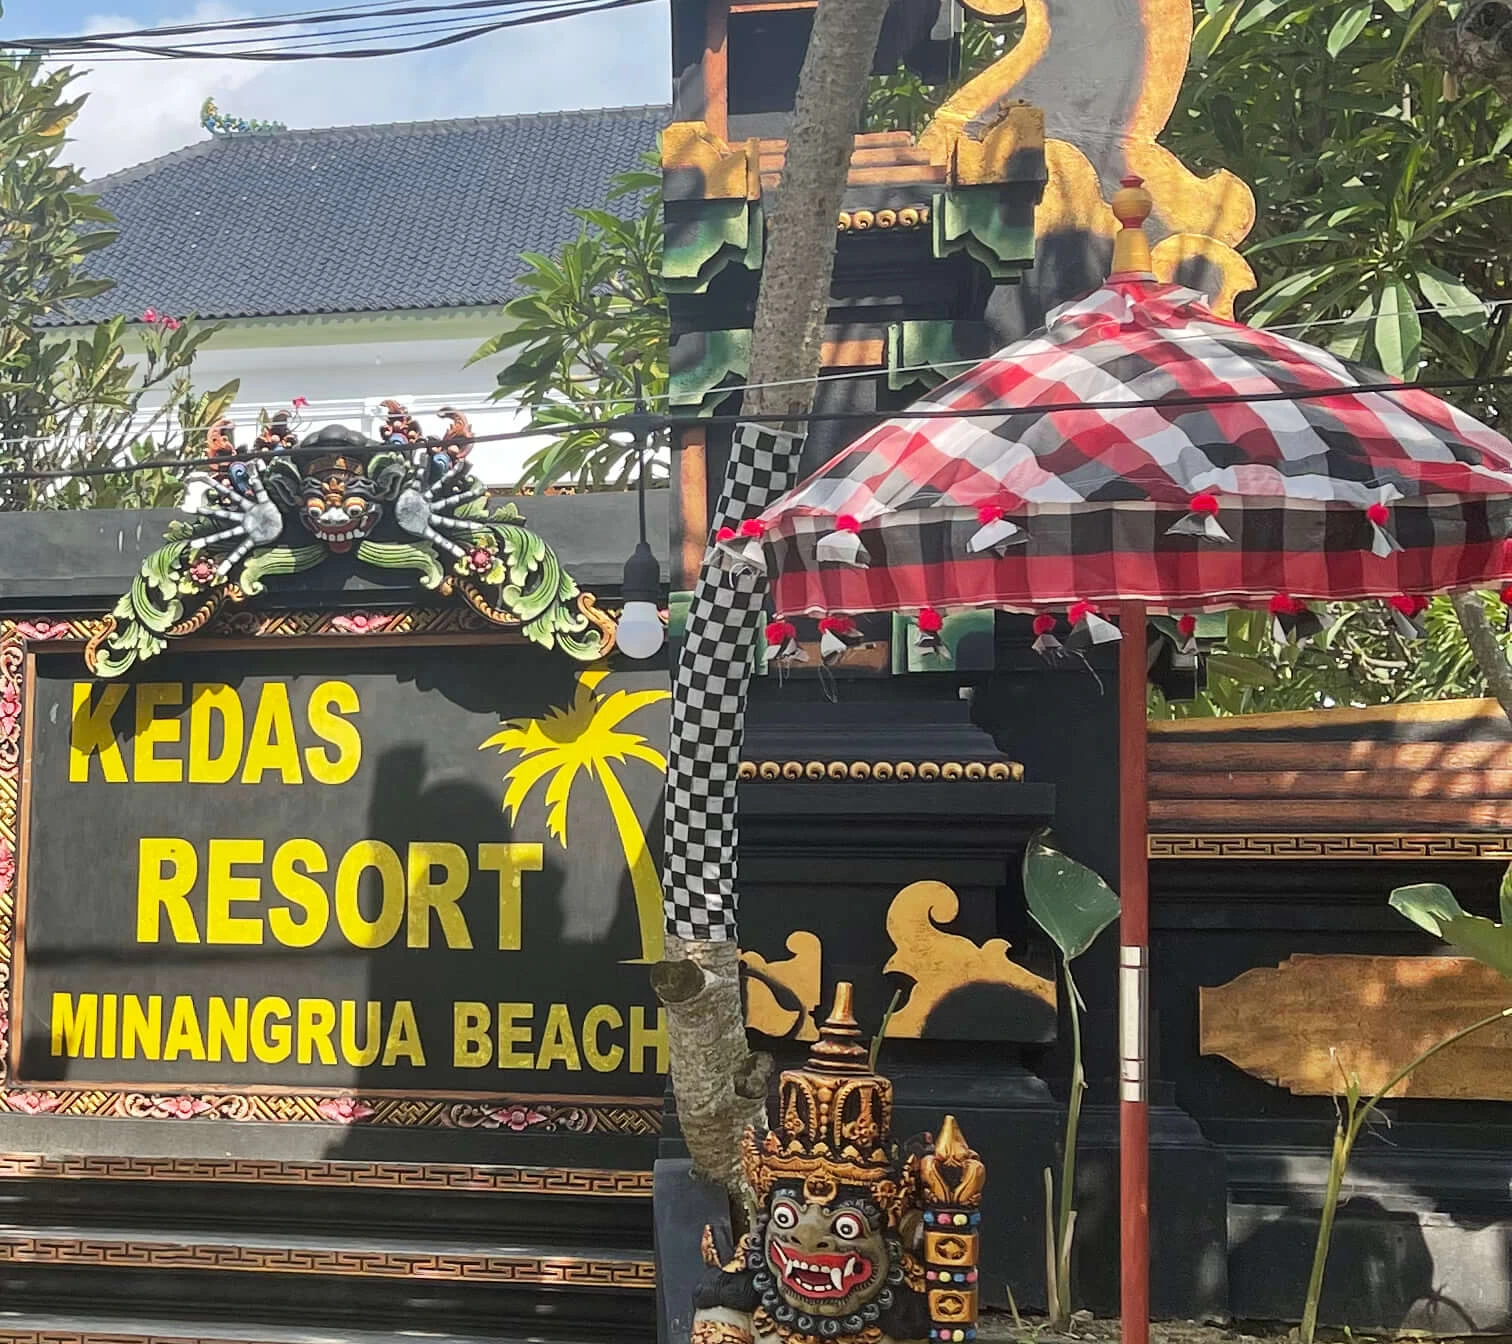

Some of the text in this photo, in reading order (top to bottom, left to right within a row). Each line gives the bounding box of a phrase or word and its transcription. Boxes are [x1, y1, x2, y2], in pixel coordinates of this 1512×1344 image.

[69, 680, 362, 785] KEDAS
[136, 837, 543, 951] RESORT
[50, 992, 670, 1074] MINANGRUA BEACH
